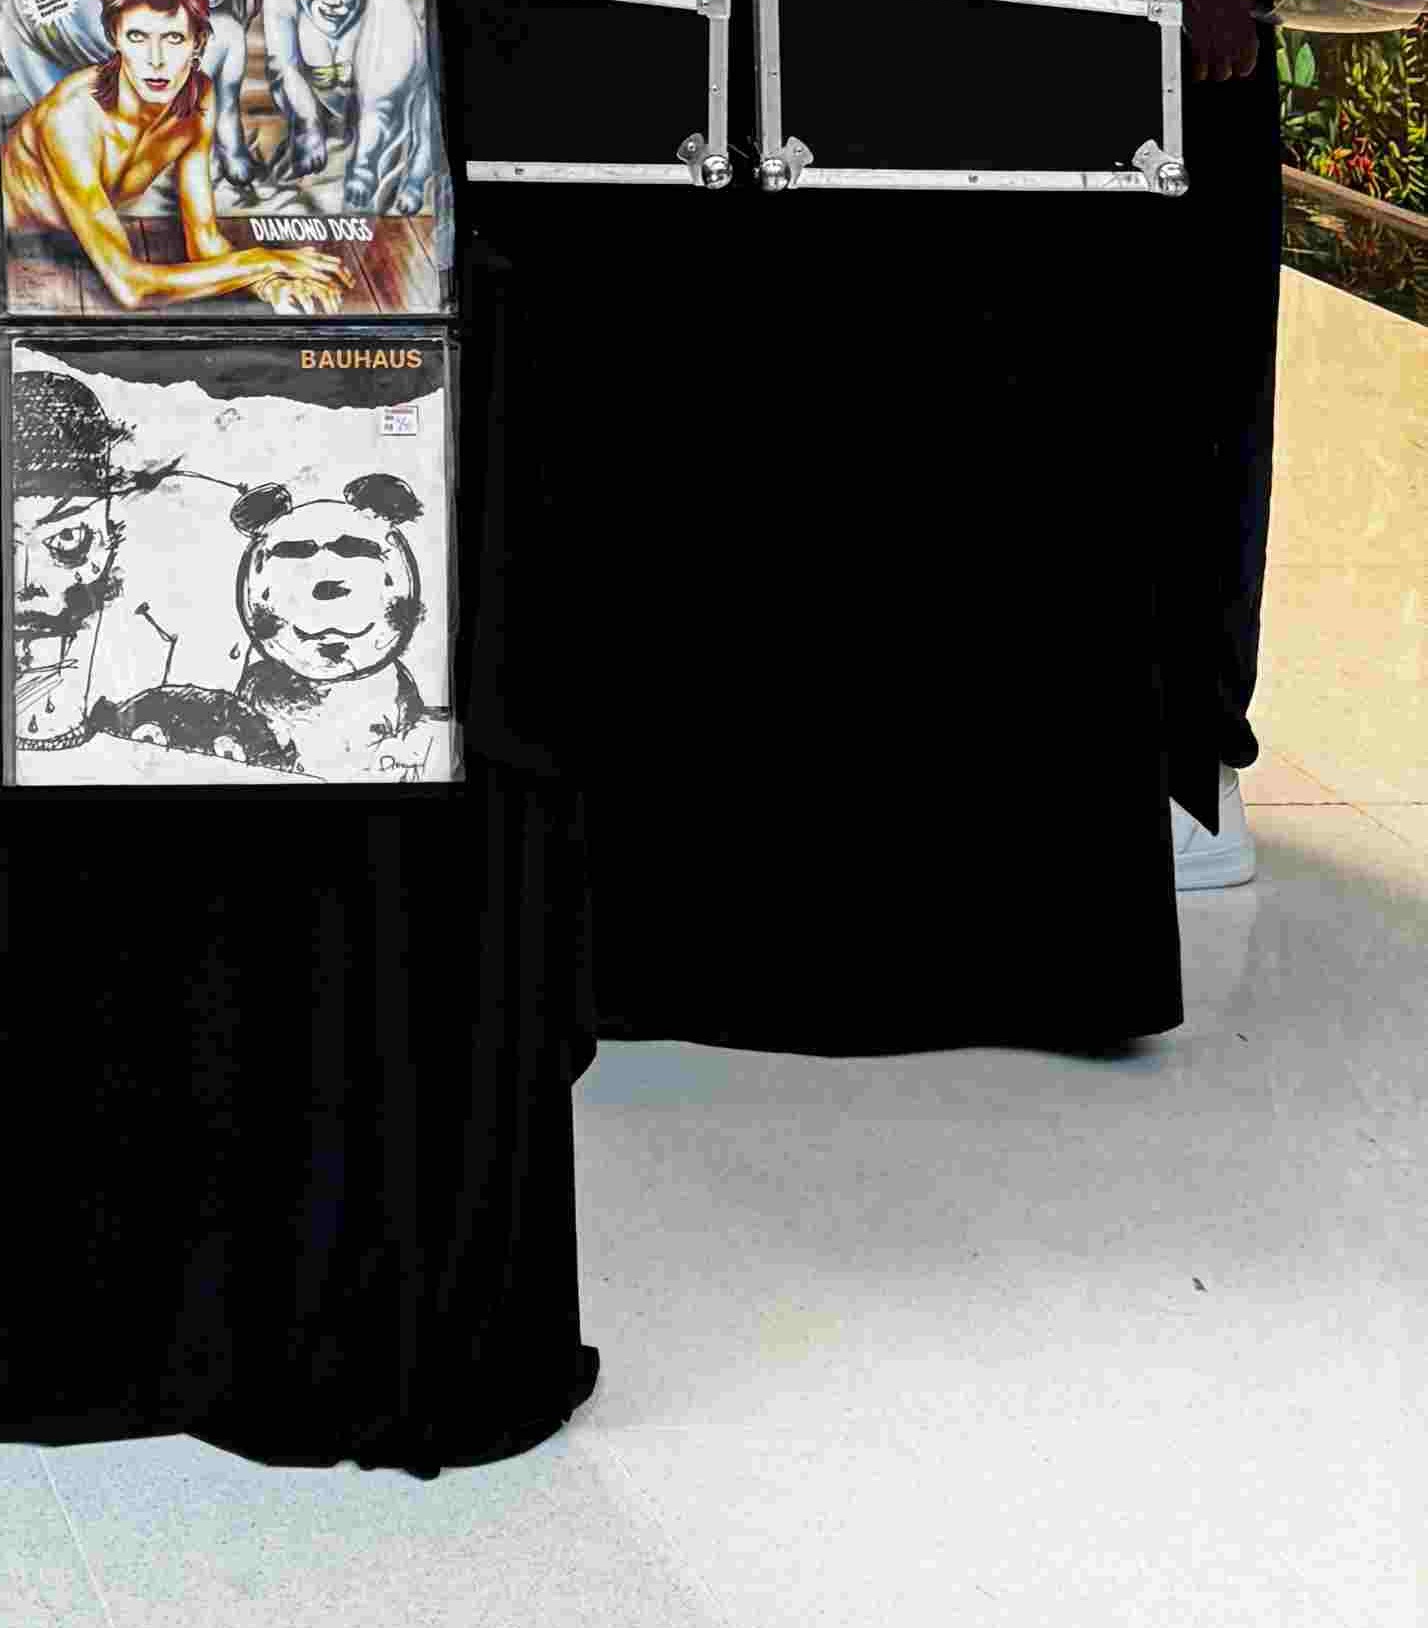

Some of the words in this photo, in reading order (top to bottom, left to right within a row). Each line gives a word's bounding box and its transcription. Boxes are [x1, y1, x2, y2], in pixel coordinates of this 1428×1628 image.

[248, 217, 328, 241] DIAMOND
[327, 217, 374, 241] DOGS
[301, 349, 423, 370] BAUHAUS
